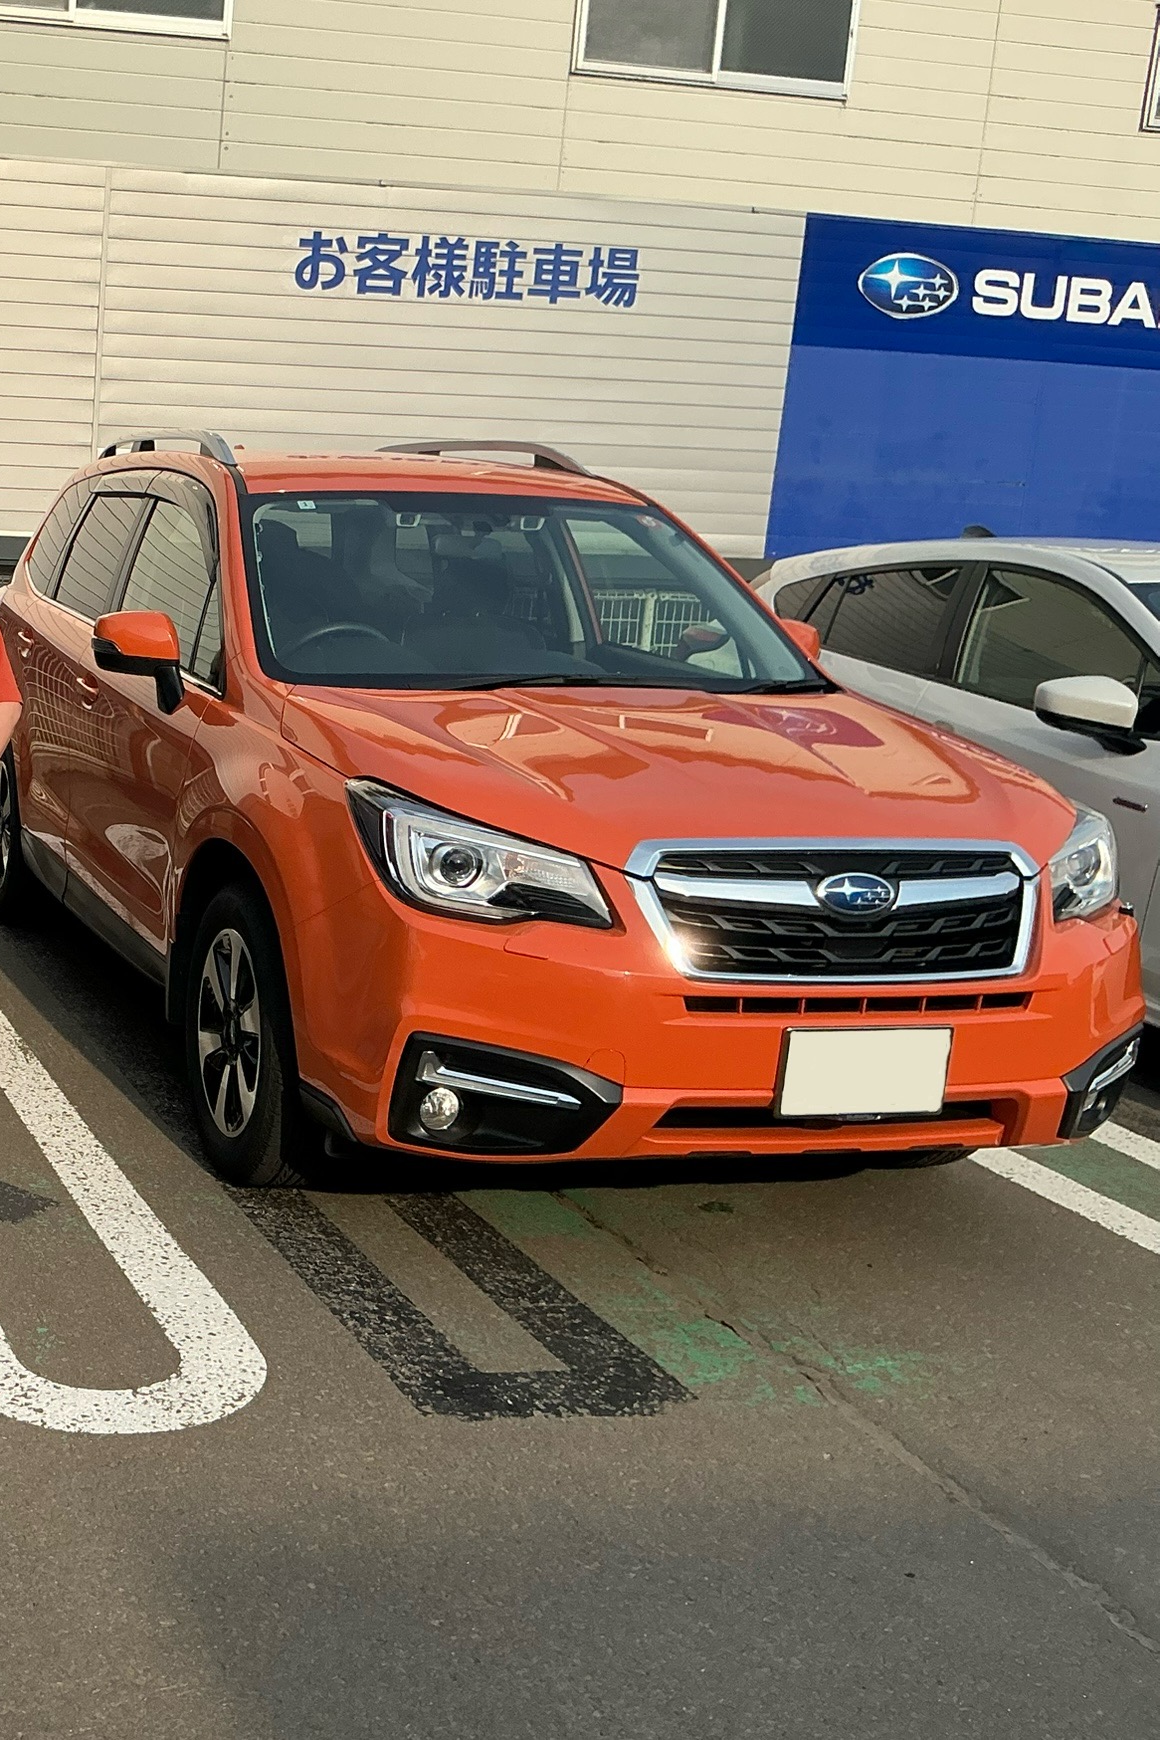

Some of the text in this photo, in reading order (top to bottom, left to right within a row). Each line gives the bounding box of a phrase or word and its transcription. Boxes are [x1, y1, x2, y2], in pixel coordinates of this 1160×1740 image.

[295, 231, 640, 308] お客様駐車場
[972, 268, 1160, 329] SUBA
